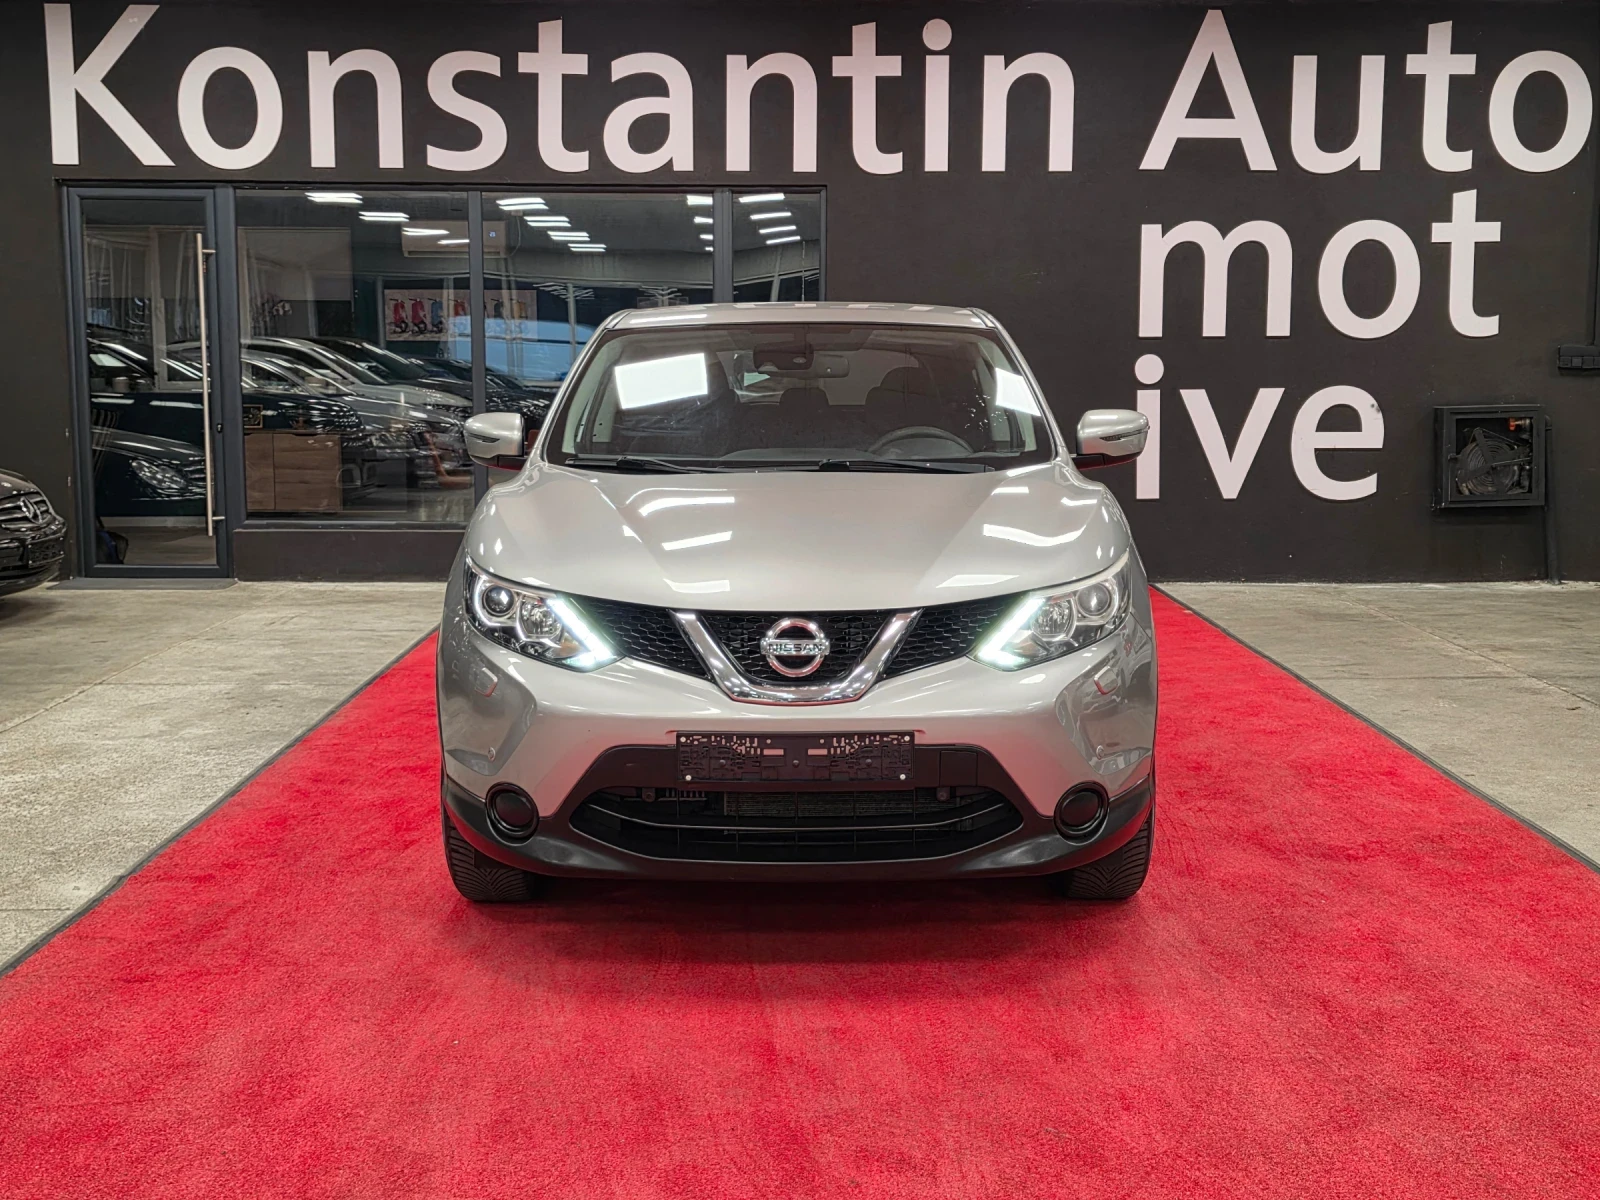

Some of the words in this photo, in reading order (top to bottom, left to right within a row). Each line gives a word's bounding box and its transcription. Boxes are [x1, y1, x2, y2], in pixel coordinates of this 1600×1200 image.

[44, 3, 1075, 174] Konstantin
[1139, 8, 1593, 174] Auto
[1137, 189, 1502, 339] mot
[1134, 354, 1385, 501] ive
[768, 643, 823, 652] NISSAN
